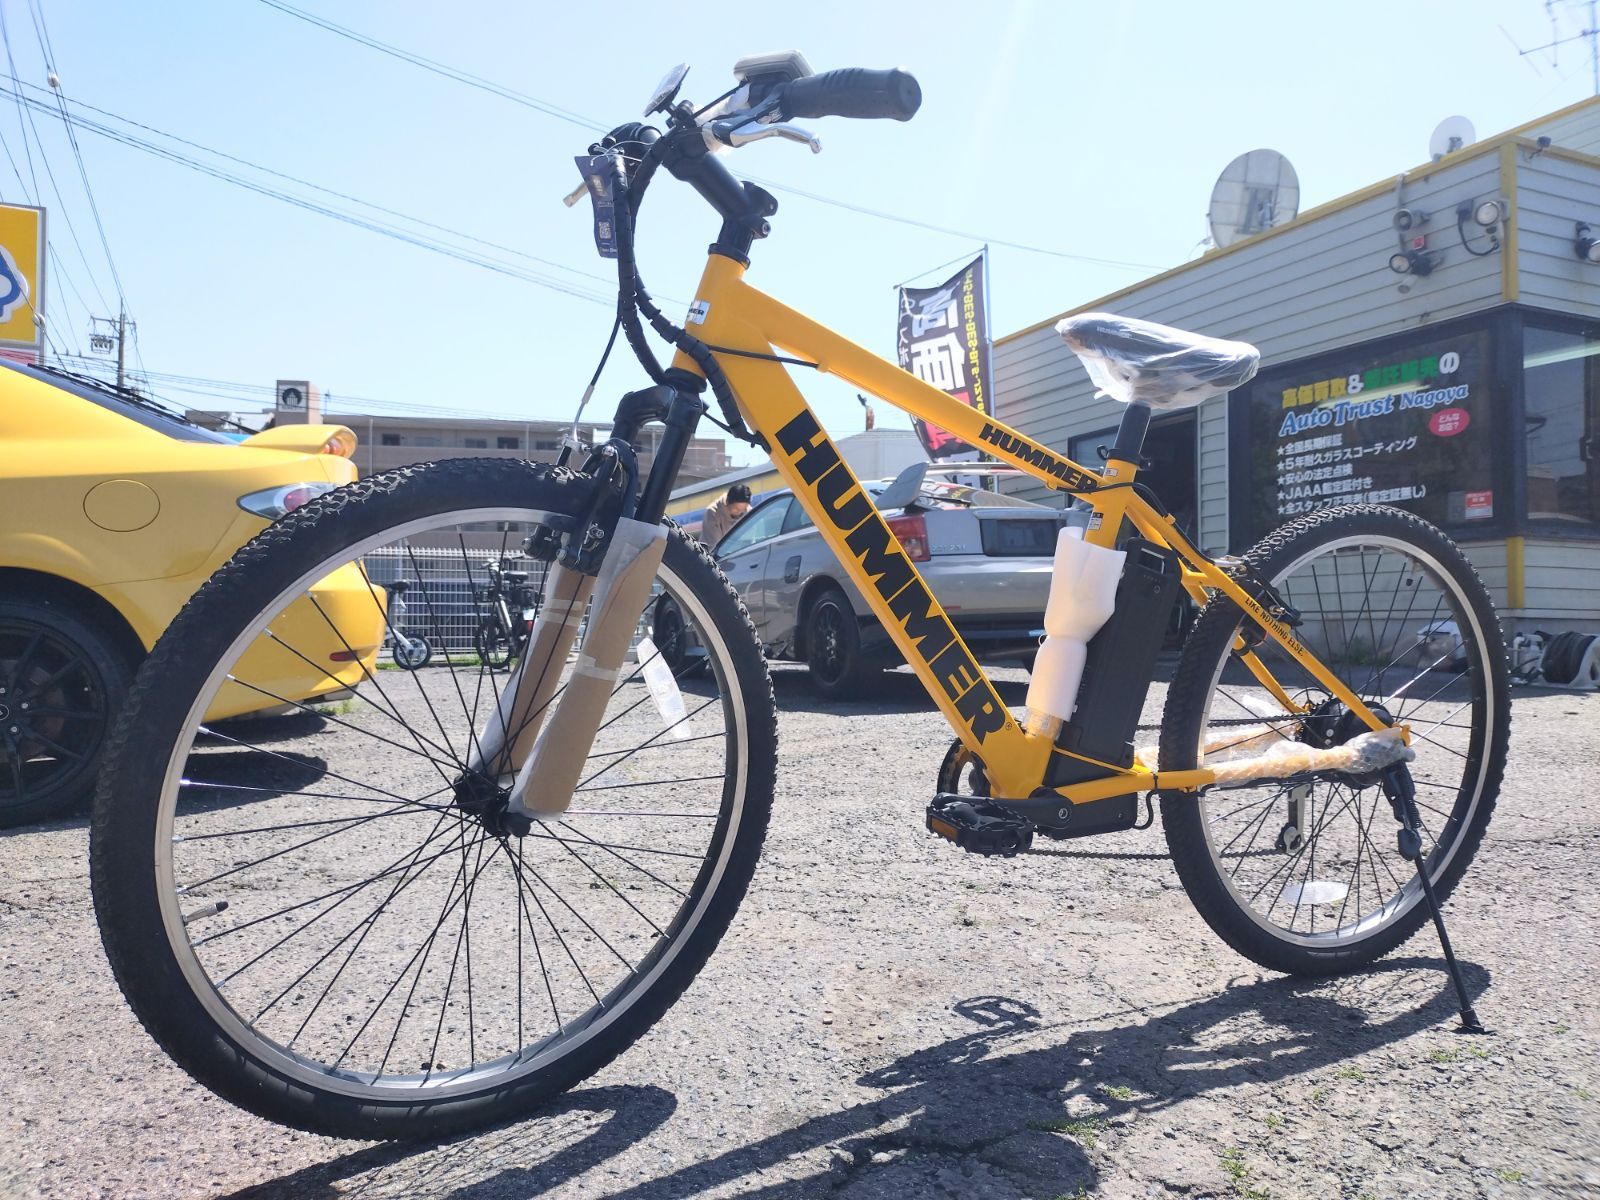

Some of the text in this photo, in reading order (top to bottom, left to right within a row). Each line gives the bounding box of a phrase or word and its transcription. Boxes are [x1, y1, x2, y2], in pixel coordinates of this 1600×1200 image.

[1278, 384, 1469, 437] Auto Trust Nagoya
[979, 423, 1100, 491] HUMMER
[774, 408, 1006, 745] HUMMER
[1245, 597, 1304, 656] LIKE NOTHING ELSE.
